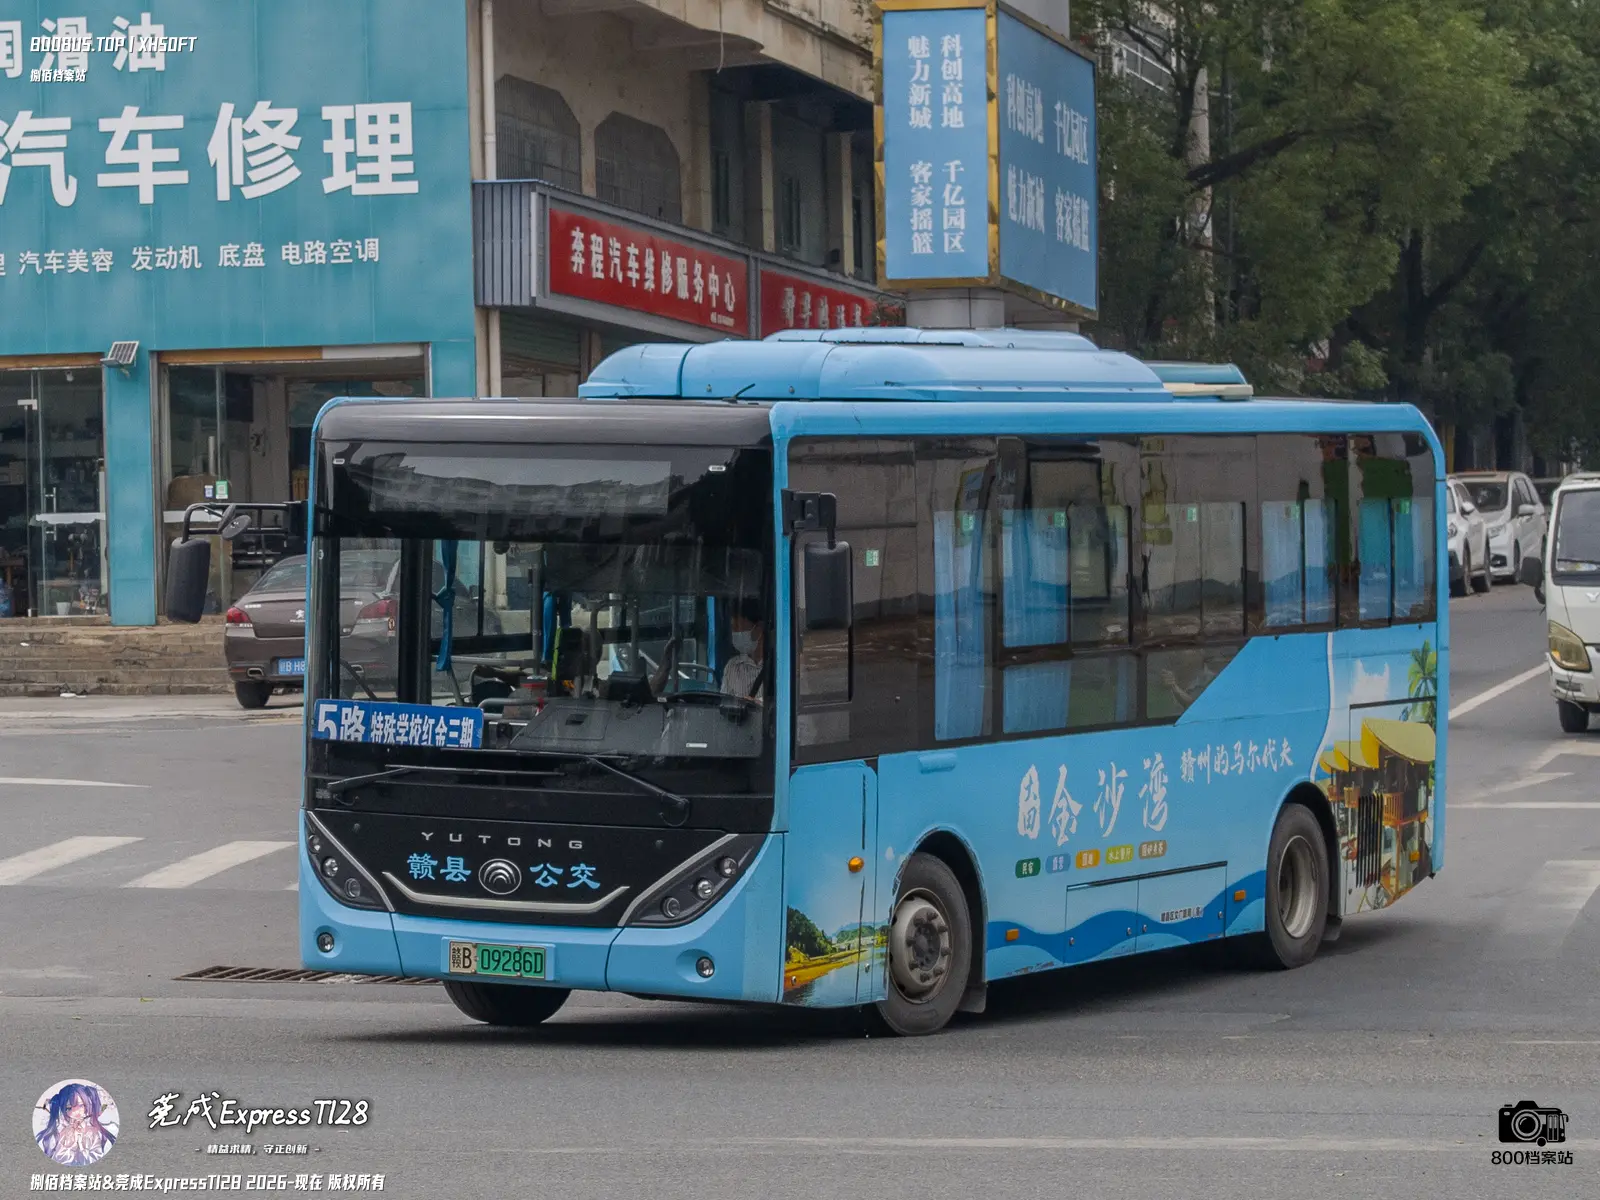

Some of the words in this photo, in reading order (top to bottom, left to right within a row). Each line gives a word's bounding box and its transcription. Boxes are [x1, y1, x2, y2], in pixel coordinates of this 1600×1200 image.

[907, 35, 933, 130] 魅力新城
[940, 34, 965, 129] 科创高地
[0, 101, 419, 207] 汽车修理
[909, 160, 934, 255] 客家摇篮
[942, 160, 966, 254] 千亿园区
[19, 248, 114, 275] 汽车美容
[131, 245, 202, 271] 发动机
[218, 243, 266, 268] 底盘
[281, 238, 380, 265] 电路空调
[570, 226, 736, 313] 奔程汽车维修服务中心
[317, 704, 366, 742] 5路
[371, 711, 475, 748] 特殊学校红金三期
[406, 853, 472, 882] 赣县
[529, 863, 601, 889] 公交
[421, 831, 583, 849] YUTONG
